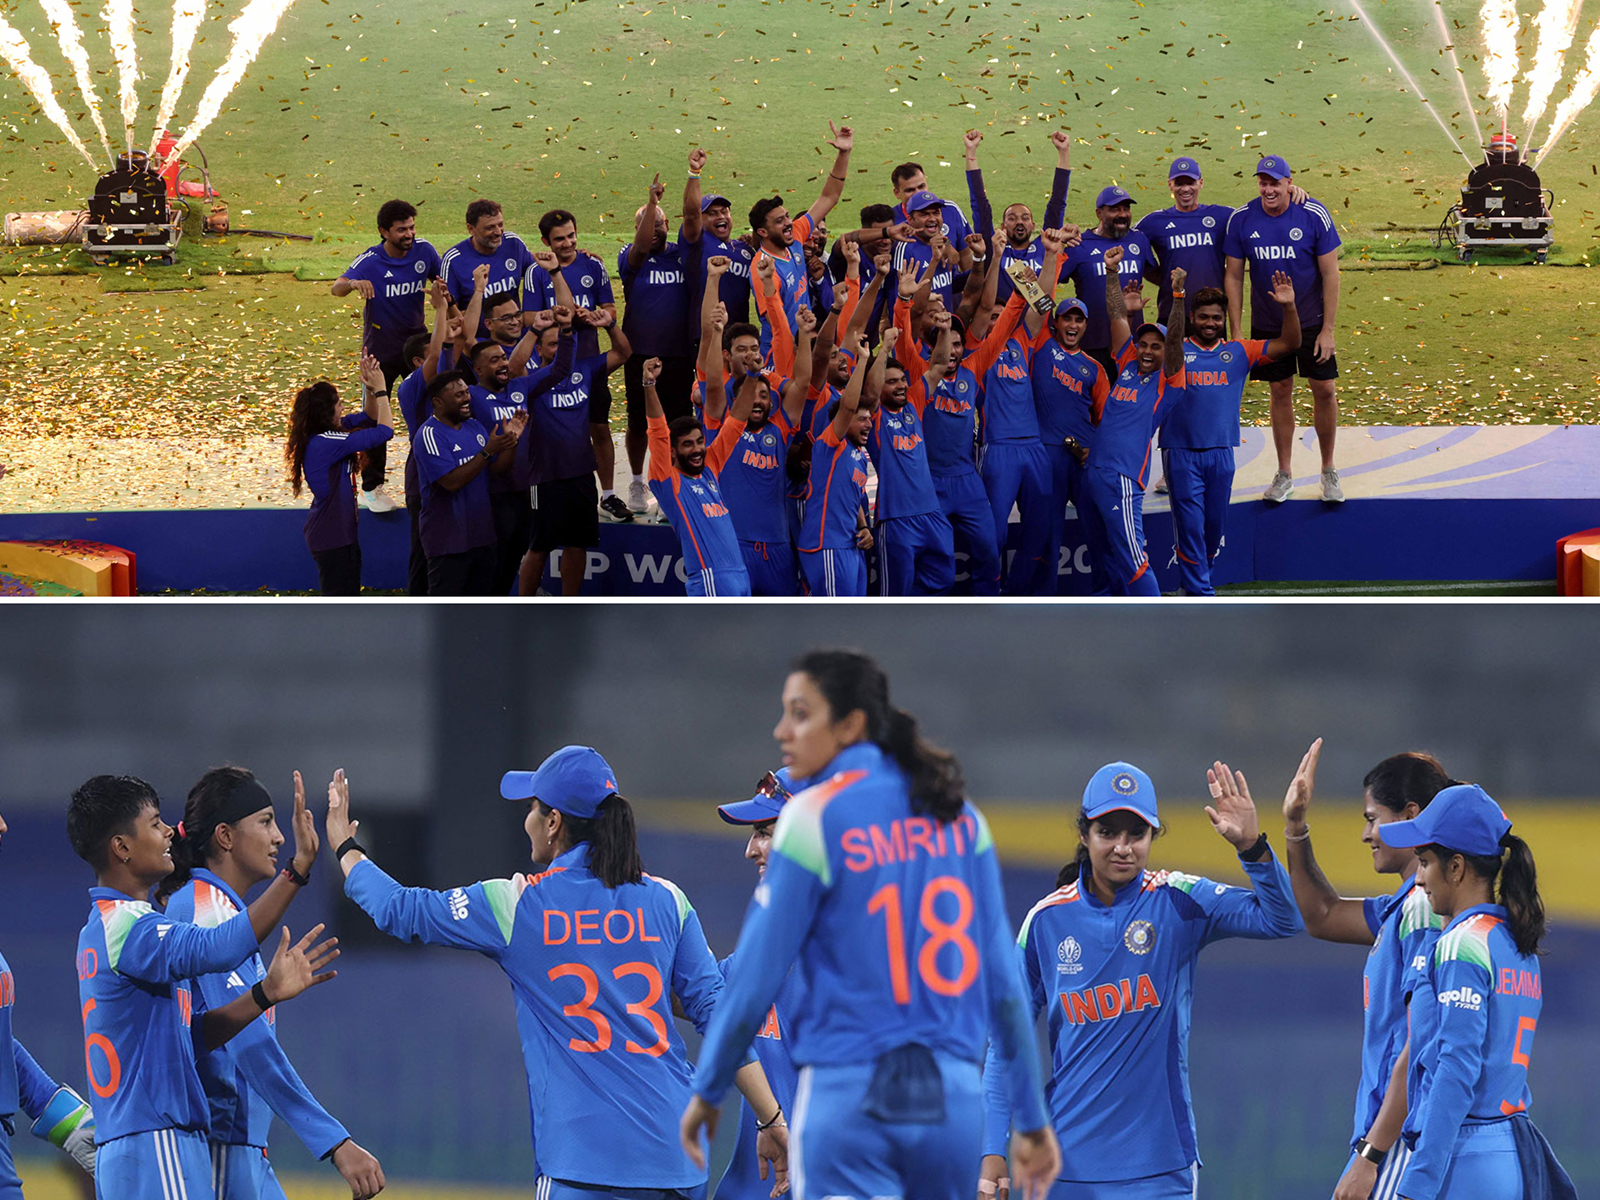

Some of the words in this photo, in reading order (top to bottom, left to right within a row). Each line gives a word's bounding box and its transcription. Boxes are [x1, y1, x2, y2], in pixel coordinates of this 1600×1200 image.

[1170, 232, 1213, 249] INDIA
[1255, 245, 1296, 260] INDIA
[386, 280, 424, 297] INDIA
[484, 276, 517, 298] NDIA
[931, 271, 952, 290] NDI
[550, 294, 590, 307] IIA
[1052, 365, 1083, 395] INDIA
[1187, 371, 1229, 385] INDIA
[552, 388, 588, 408] INDIA
[935, 395, 972, 413] INDIA
[493, 405, 527, 420] IND
[742, 449, 779, 469] INDIA
[840, 815, 976, 873] SMRITI
[543, 908, 660, 945] DEOL
[867, 875, 980, 1004] 18
[1495, 967, 1542, 1000] JEMIM
[1059, 973, 1160, 1025] INDIA
[1438, 986, 1482, 1007] apollo
[547, 961, 670, 1058] 33
